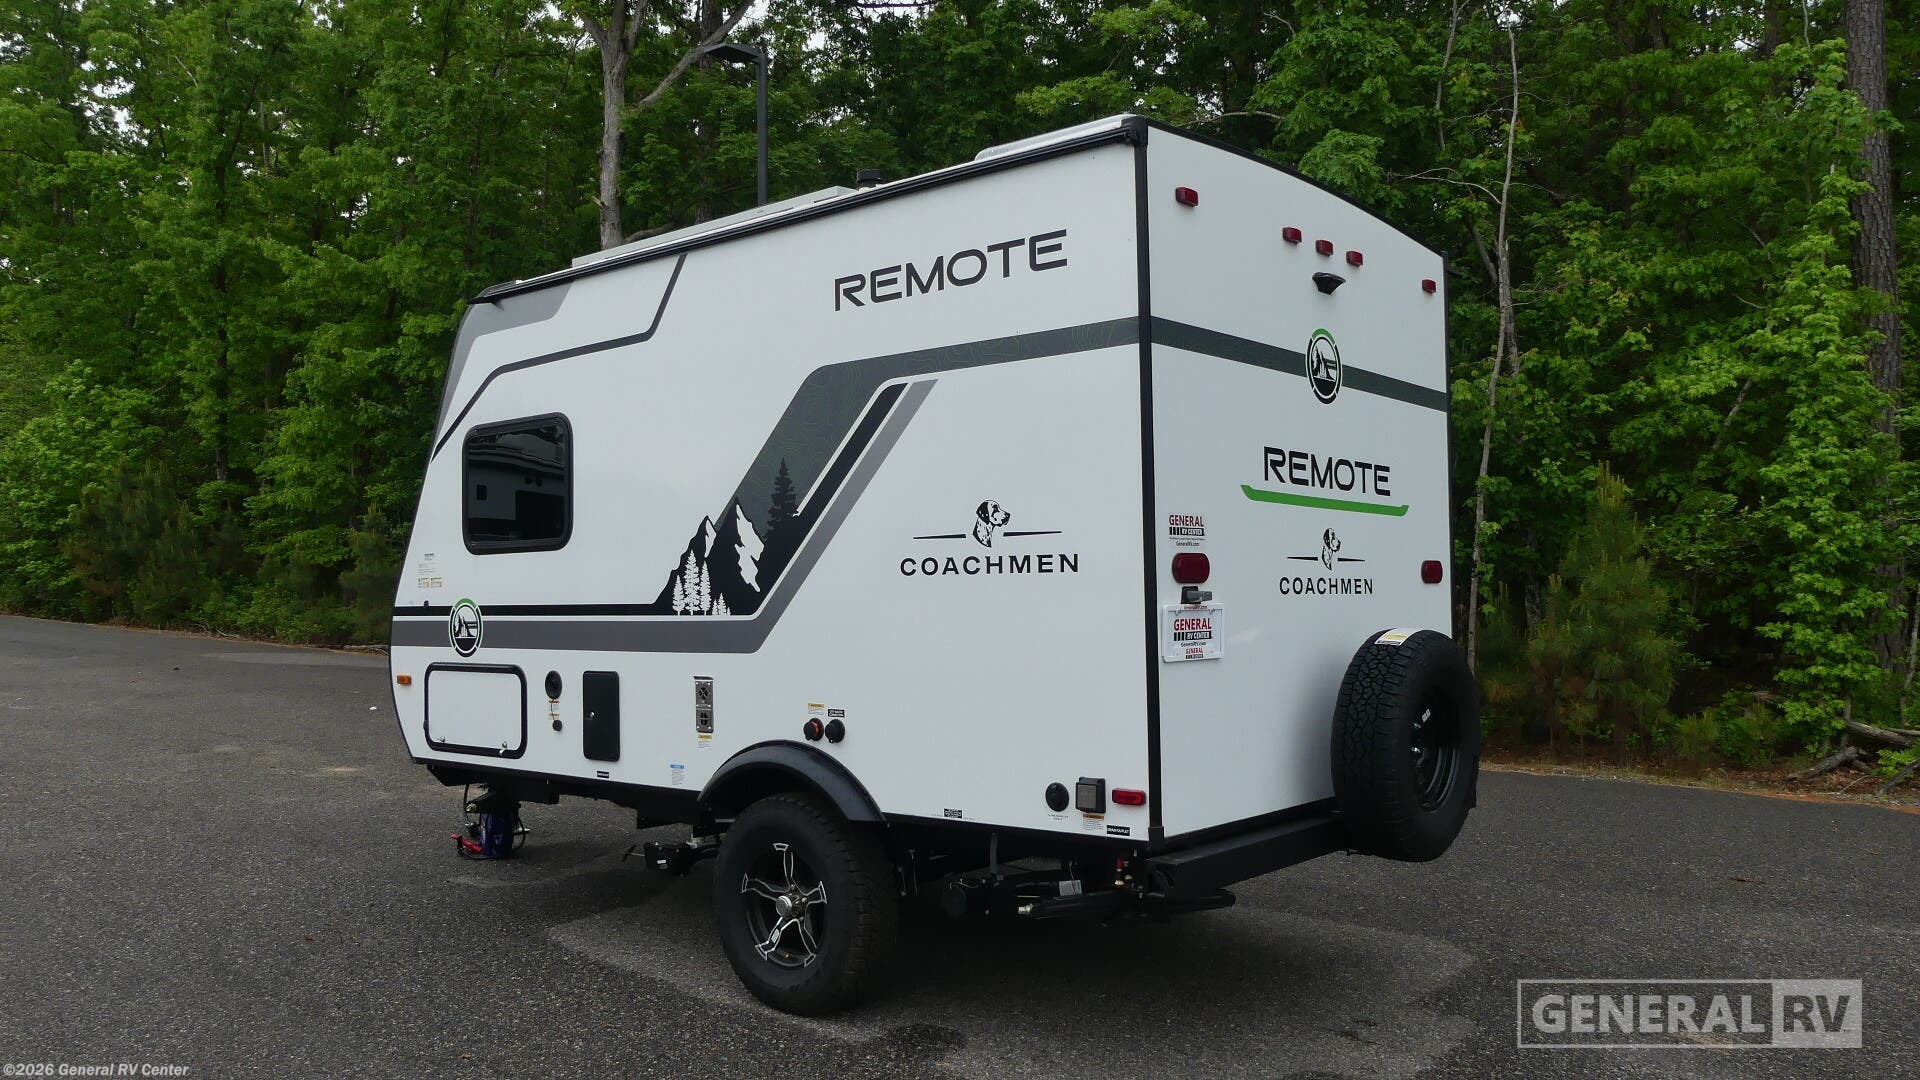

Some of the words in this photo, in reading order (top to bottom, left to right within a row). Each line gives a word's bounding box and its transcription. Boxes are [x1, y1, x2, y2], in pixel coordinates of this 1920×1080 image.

[834, 229, 1068, 312] REMOTE
[1263, 446, 1391, 496] REMOTE
[1169, 514, 1204, 527] GENERAL
[900, 553, 1079, 576] COACHMEN
[1279, 576, 1373, 595] COACHMEN
[1174, 618, 1212, 631] GENERAL
